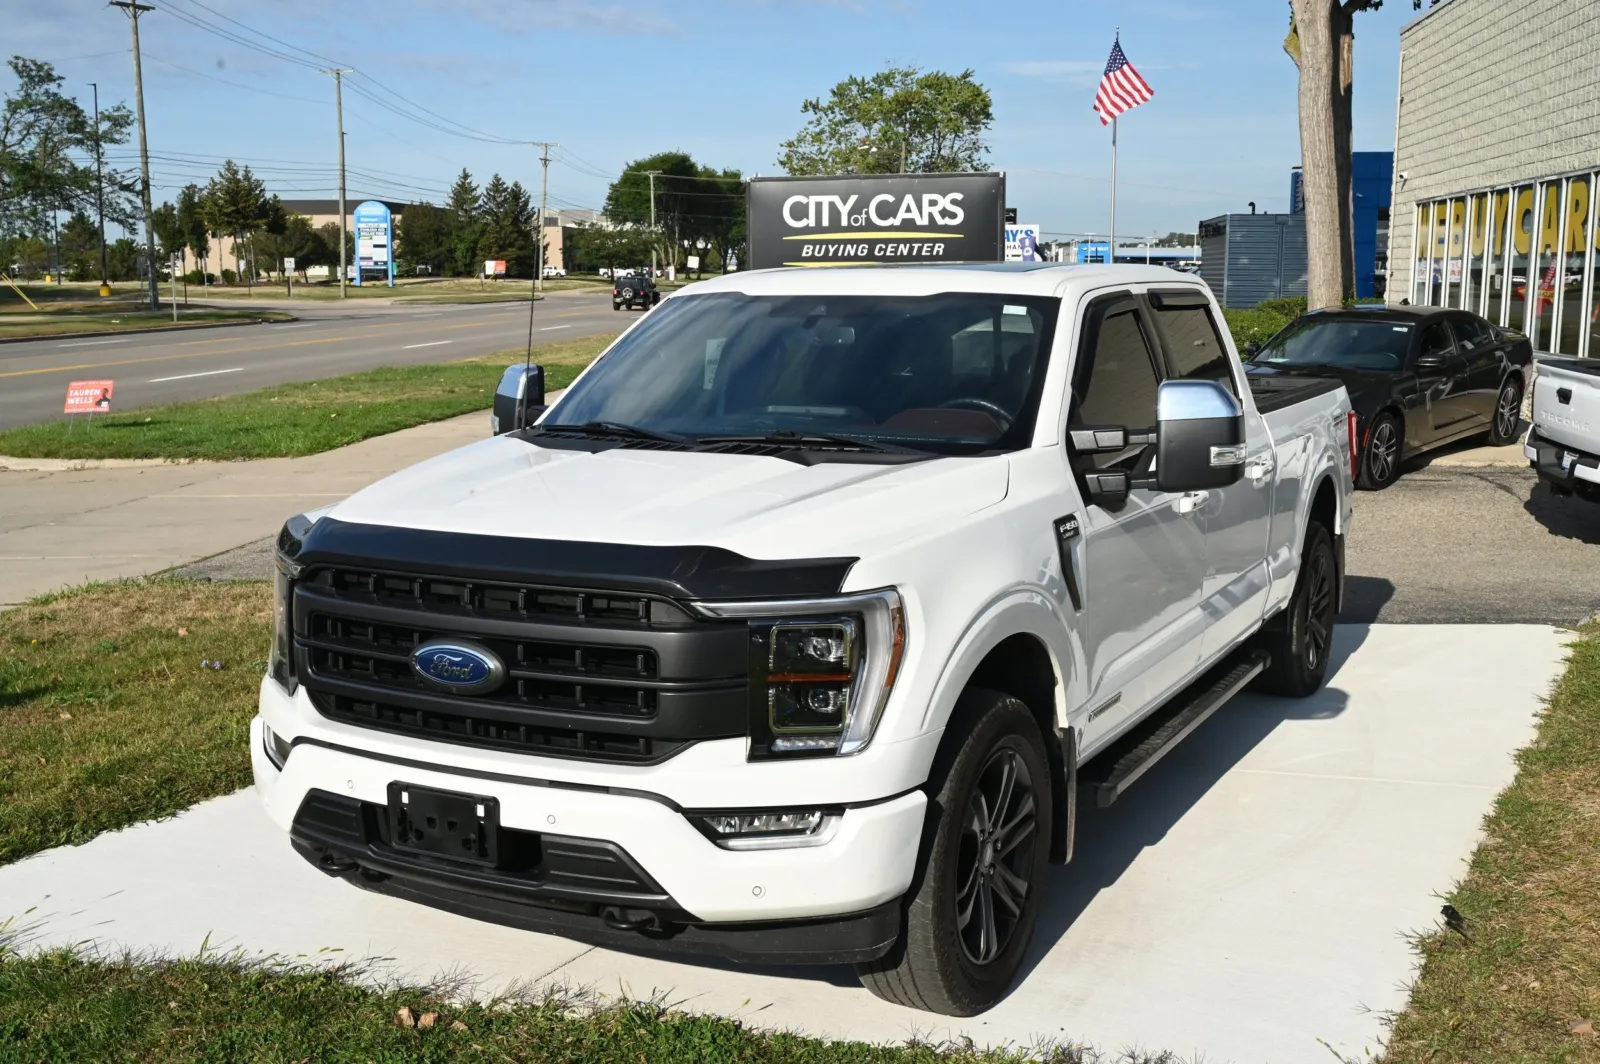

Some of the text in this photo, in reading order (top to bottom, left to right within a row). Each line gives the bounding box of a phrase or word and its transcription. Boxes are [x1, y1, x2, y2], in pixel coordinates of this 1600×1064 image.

[782, 192, 965, 228] CITY of CARS
[1449, 193, 1510, 258] BUY
[801, 242, 945, 257] BUYING CENTER
[67, 396, 93, 405] WELLS
[69, 388, 100, 397] TAUREN
[430, 653, 474, 679] Ford
